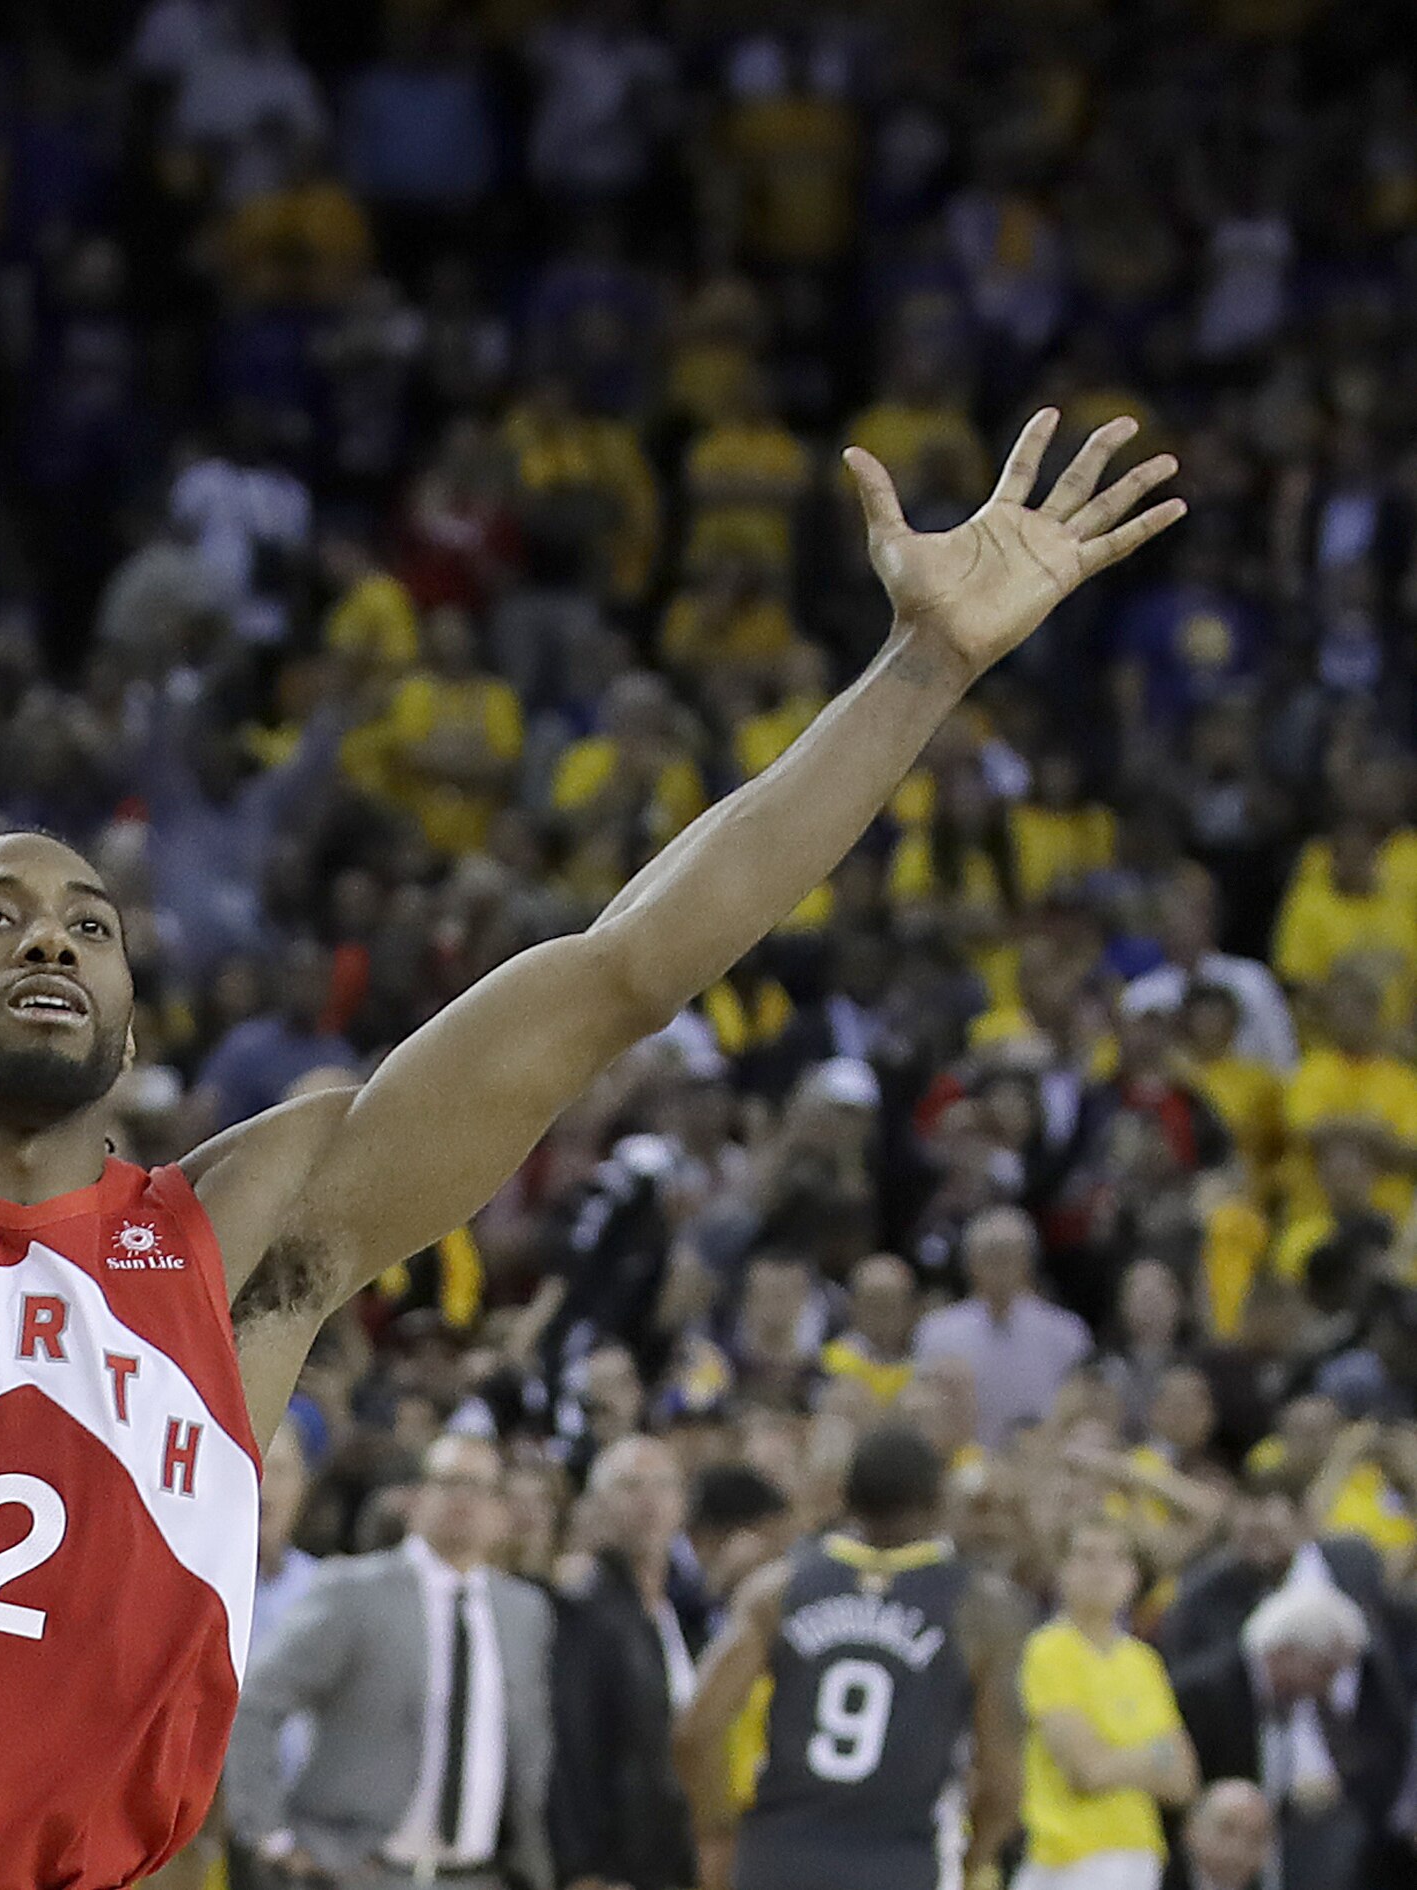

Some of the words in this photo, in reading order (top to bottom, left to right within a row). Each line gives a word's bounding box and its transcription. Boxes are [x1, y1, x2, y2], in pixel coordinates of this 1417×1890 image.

[106, 1257, 146, 1269] Sun
[148, 1255, 185, 1269] Life
[806, 1658, 894, 1784] 9
